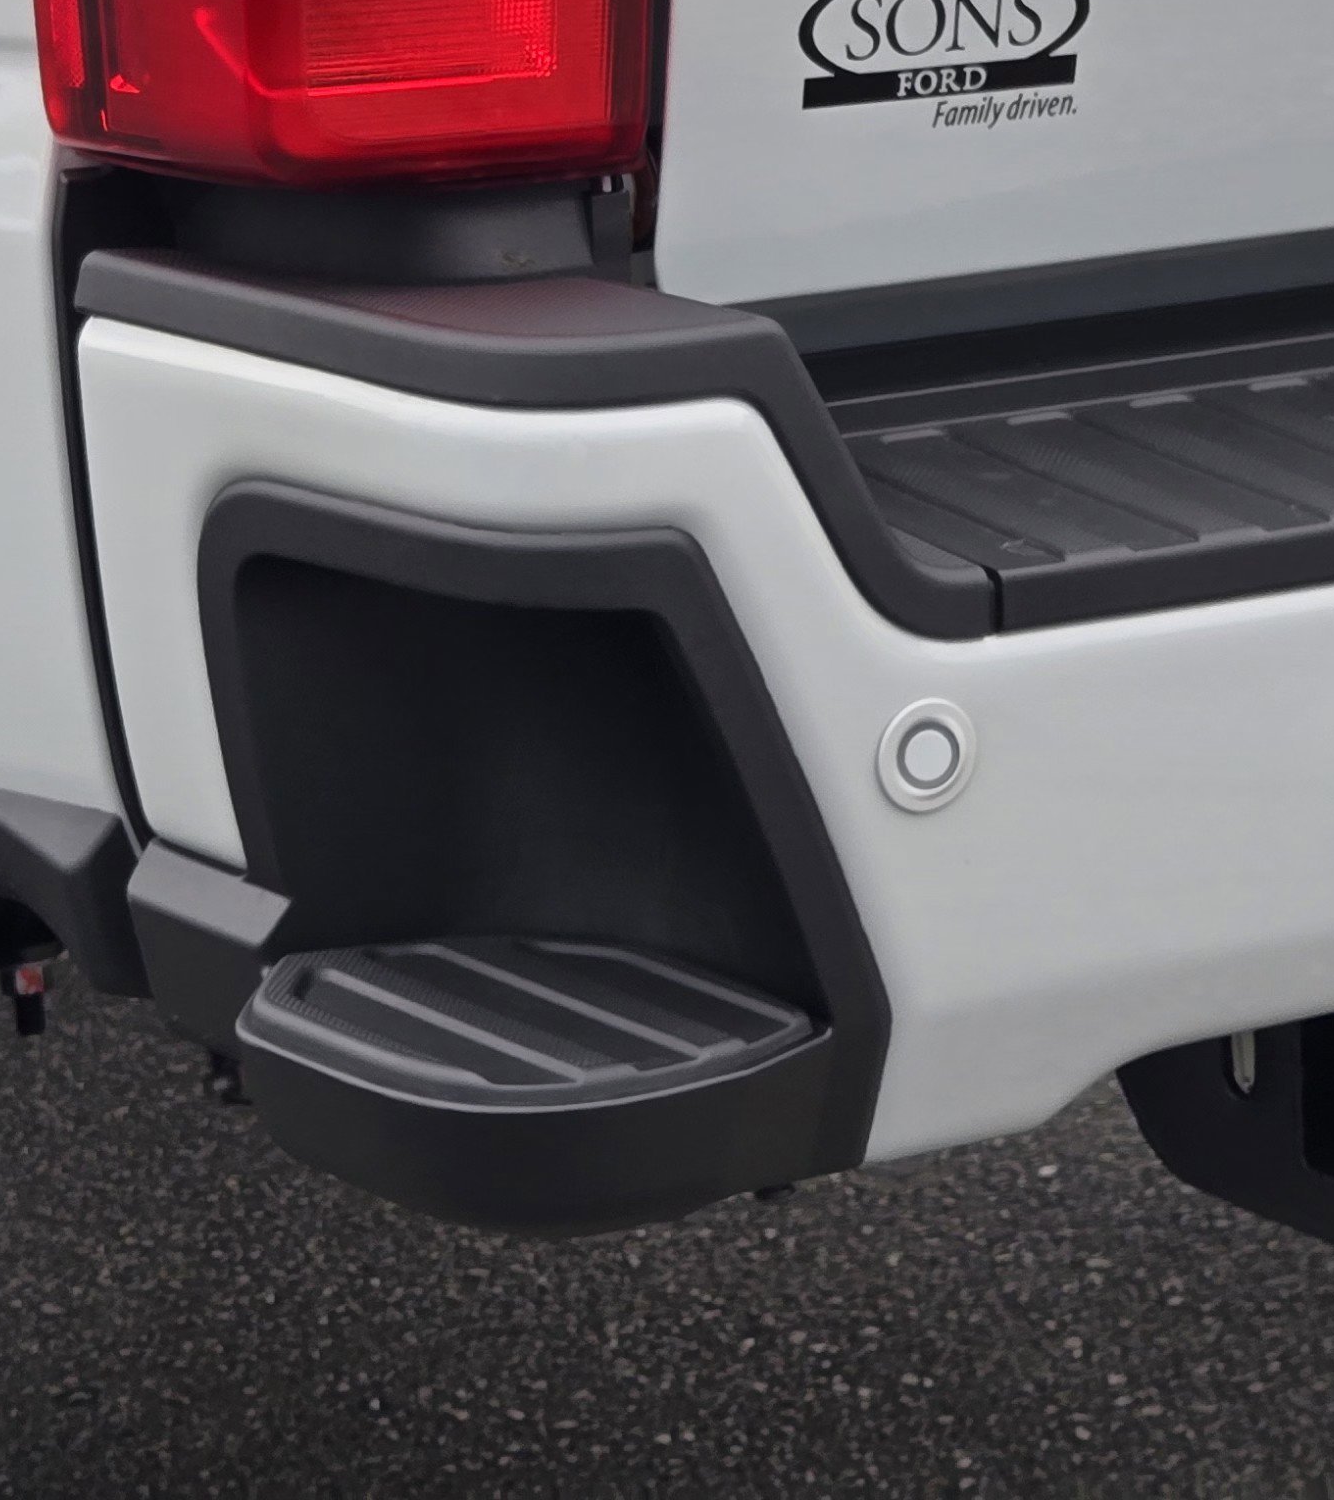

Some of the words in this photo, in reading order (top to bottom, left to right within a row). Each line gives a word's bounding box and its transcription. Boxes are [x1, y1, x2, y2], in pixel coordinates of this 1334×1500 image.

[896, 65, 989, 98] FORD
[931, 96, 1004, 130] Family
[1006, 93, 1078, 121] driven.
